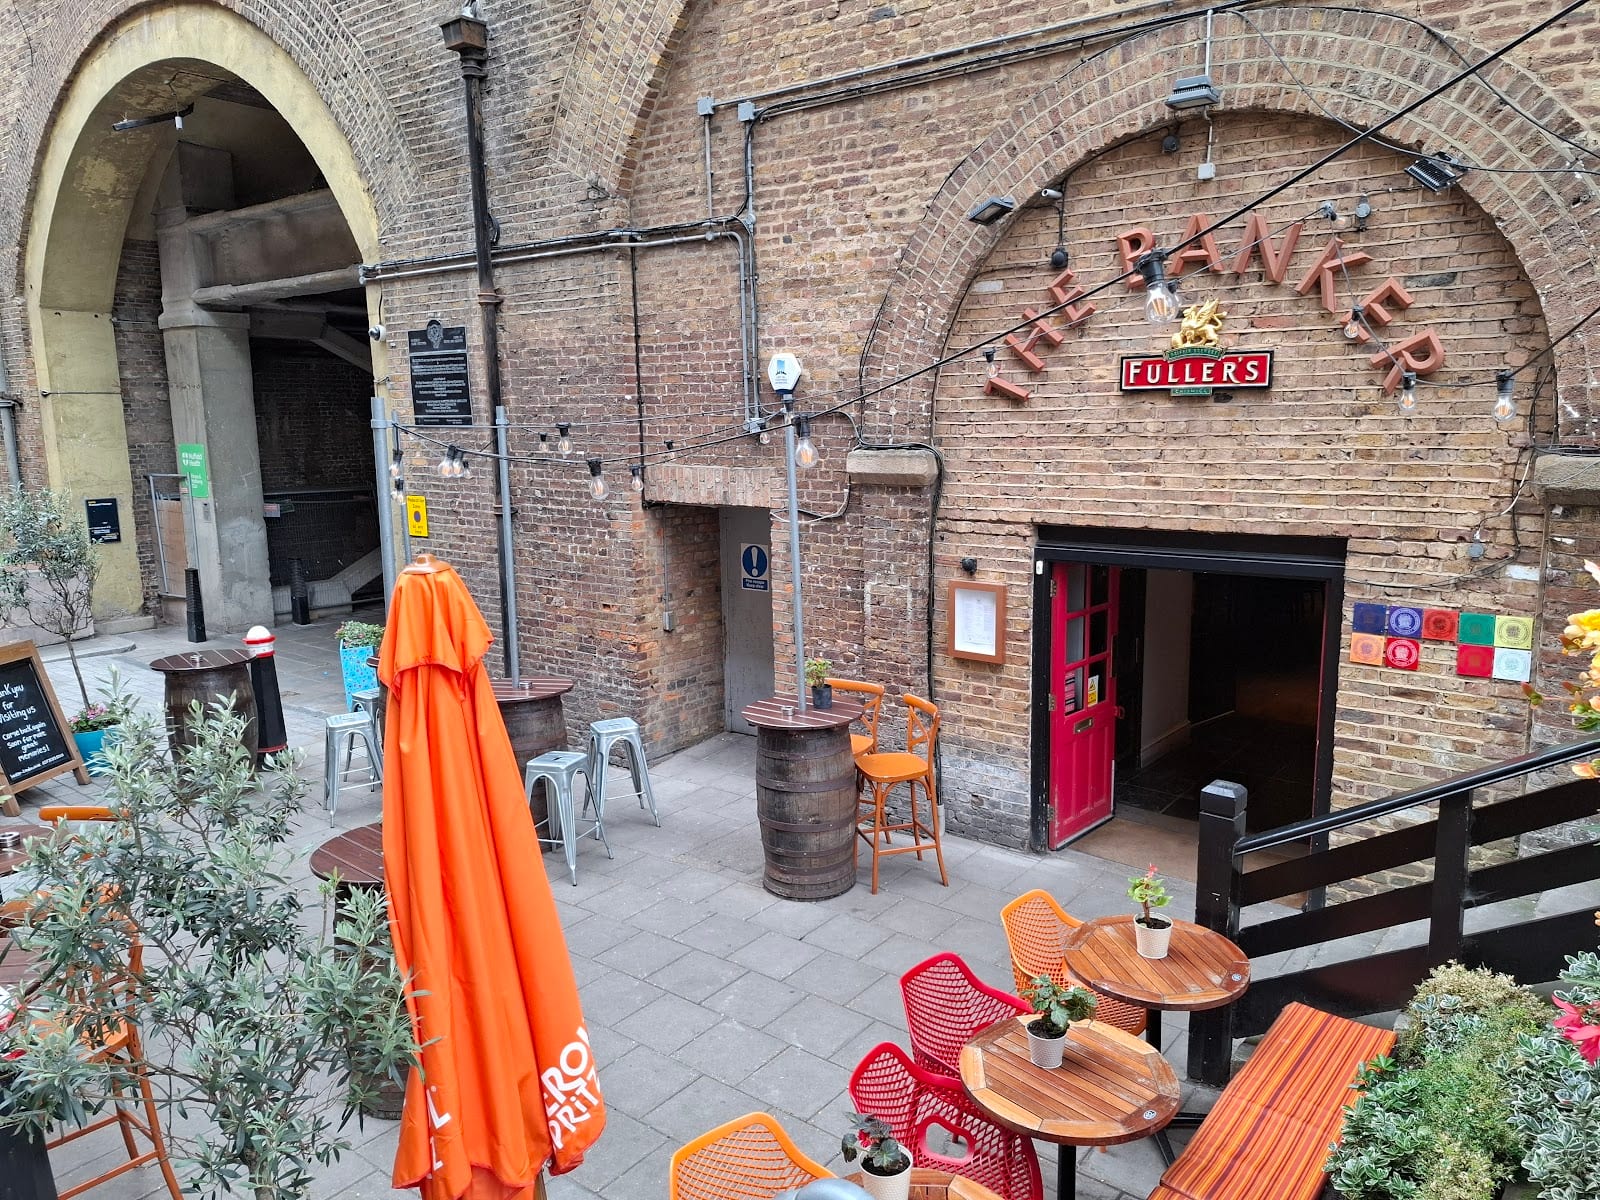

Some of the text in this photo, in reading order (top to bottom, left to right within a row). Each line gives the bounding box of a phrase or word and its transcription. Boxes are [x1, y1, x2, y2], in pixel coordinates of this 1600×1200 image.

[984, 213, 1445, 401] THE BANKER
[1129, 357, 1259, 384] FULLER'S
[11, 684, 24, 698] you
[2, 701, 14, 710] for
[27, 706, 36, 714] us
